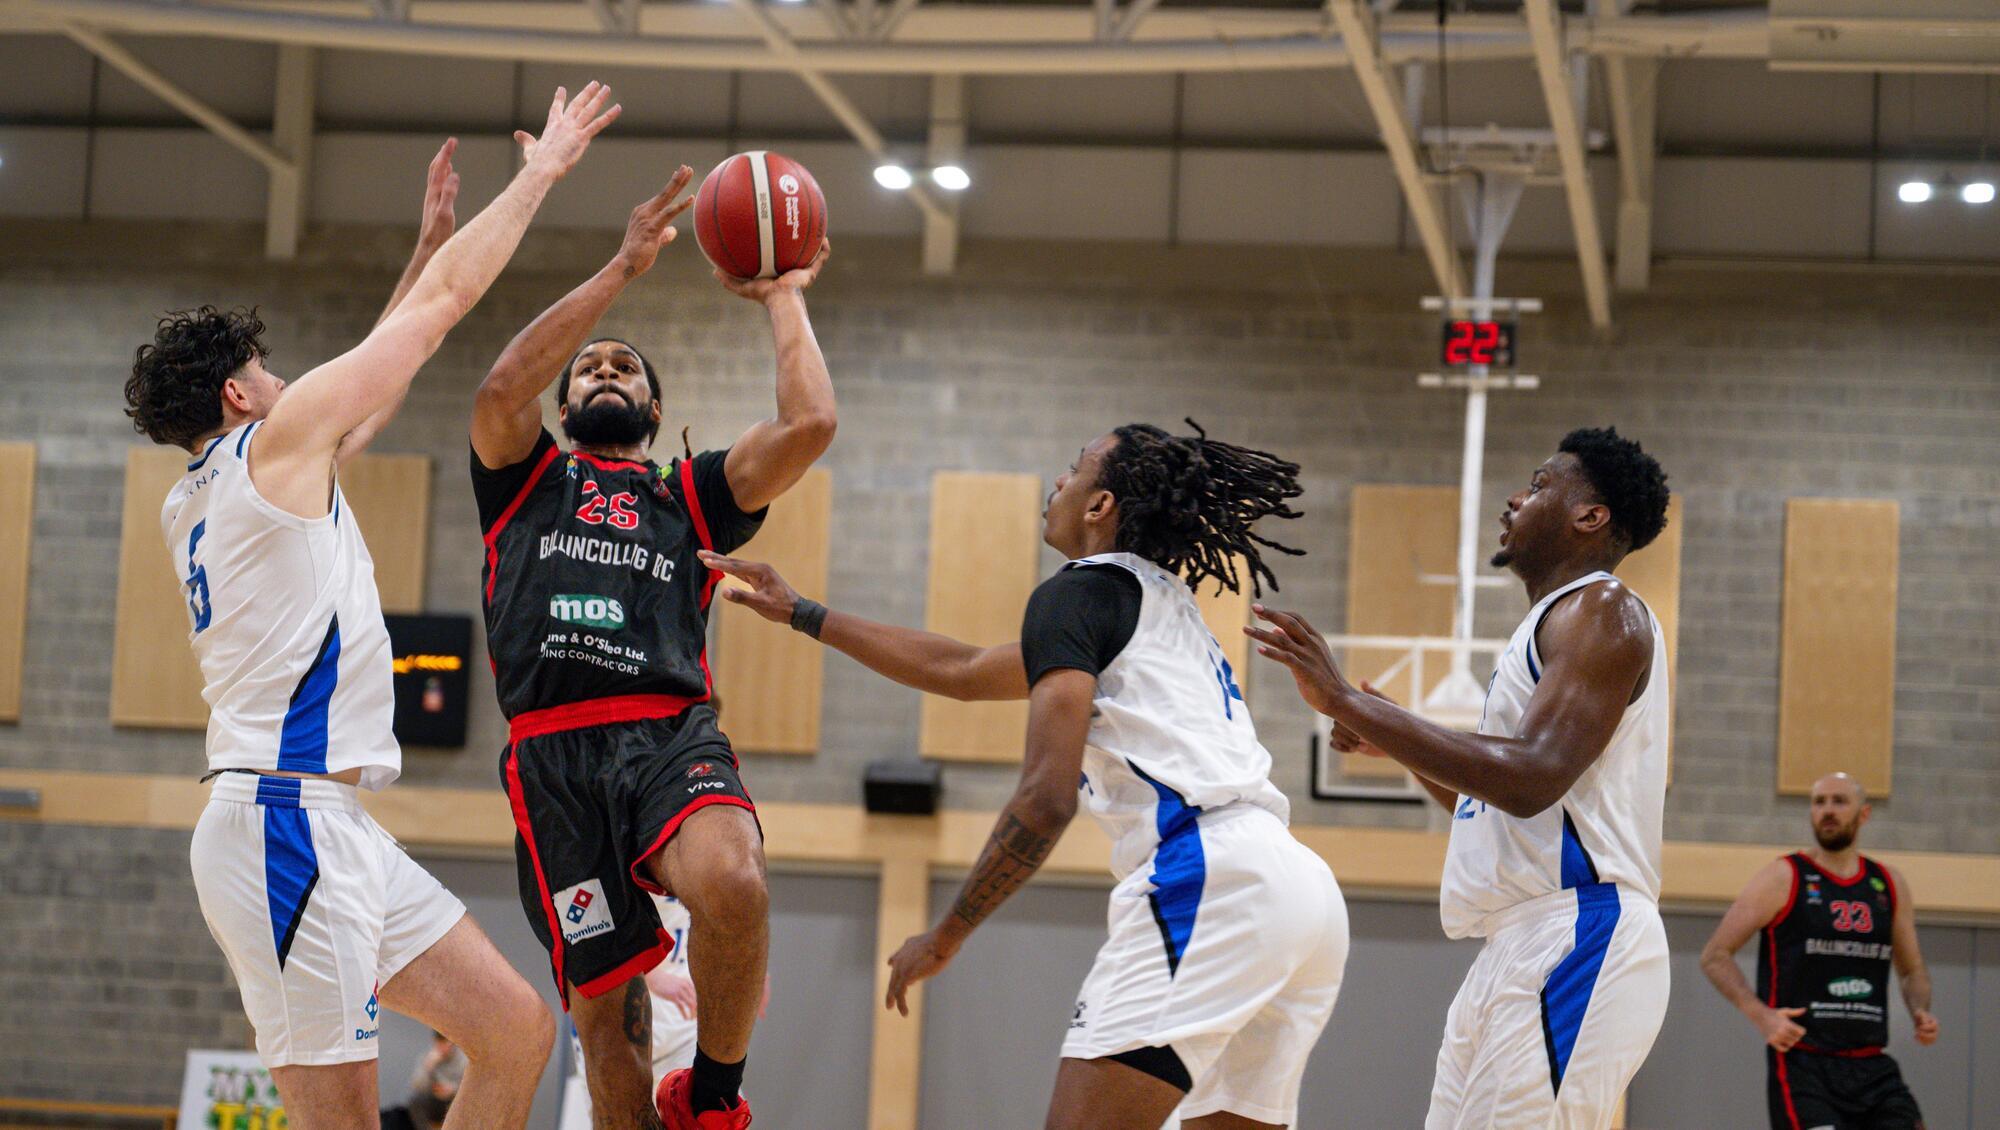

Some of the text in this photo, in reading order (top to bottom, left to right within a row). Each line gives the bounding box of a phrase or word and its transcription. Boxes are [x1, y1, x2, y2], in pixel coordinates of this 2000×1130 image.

[1446, 321, 1499, 364] 22
[576, 480, 639, 530] 25
[652, 552, 675, 582] BC
[550, 599, 625, 623] mos
[570, 632, 580, 643] &
[625, 646, 647, 661] Ltd.
[688, 781, 726, 793] vivo
[1830, 900, 1873, 933] 33
[566, 920, 611, 943] Domino's
